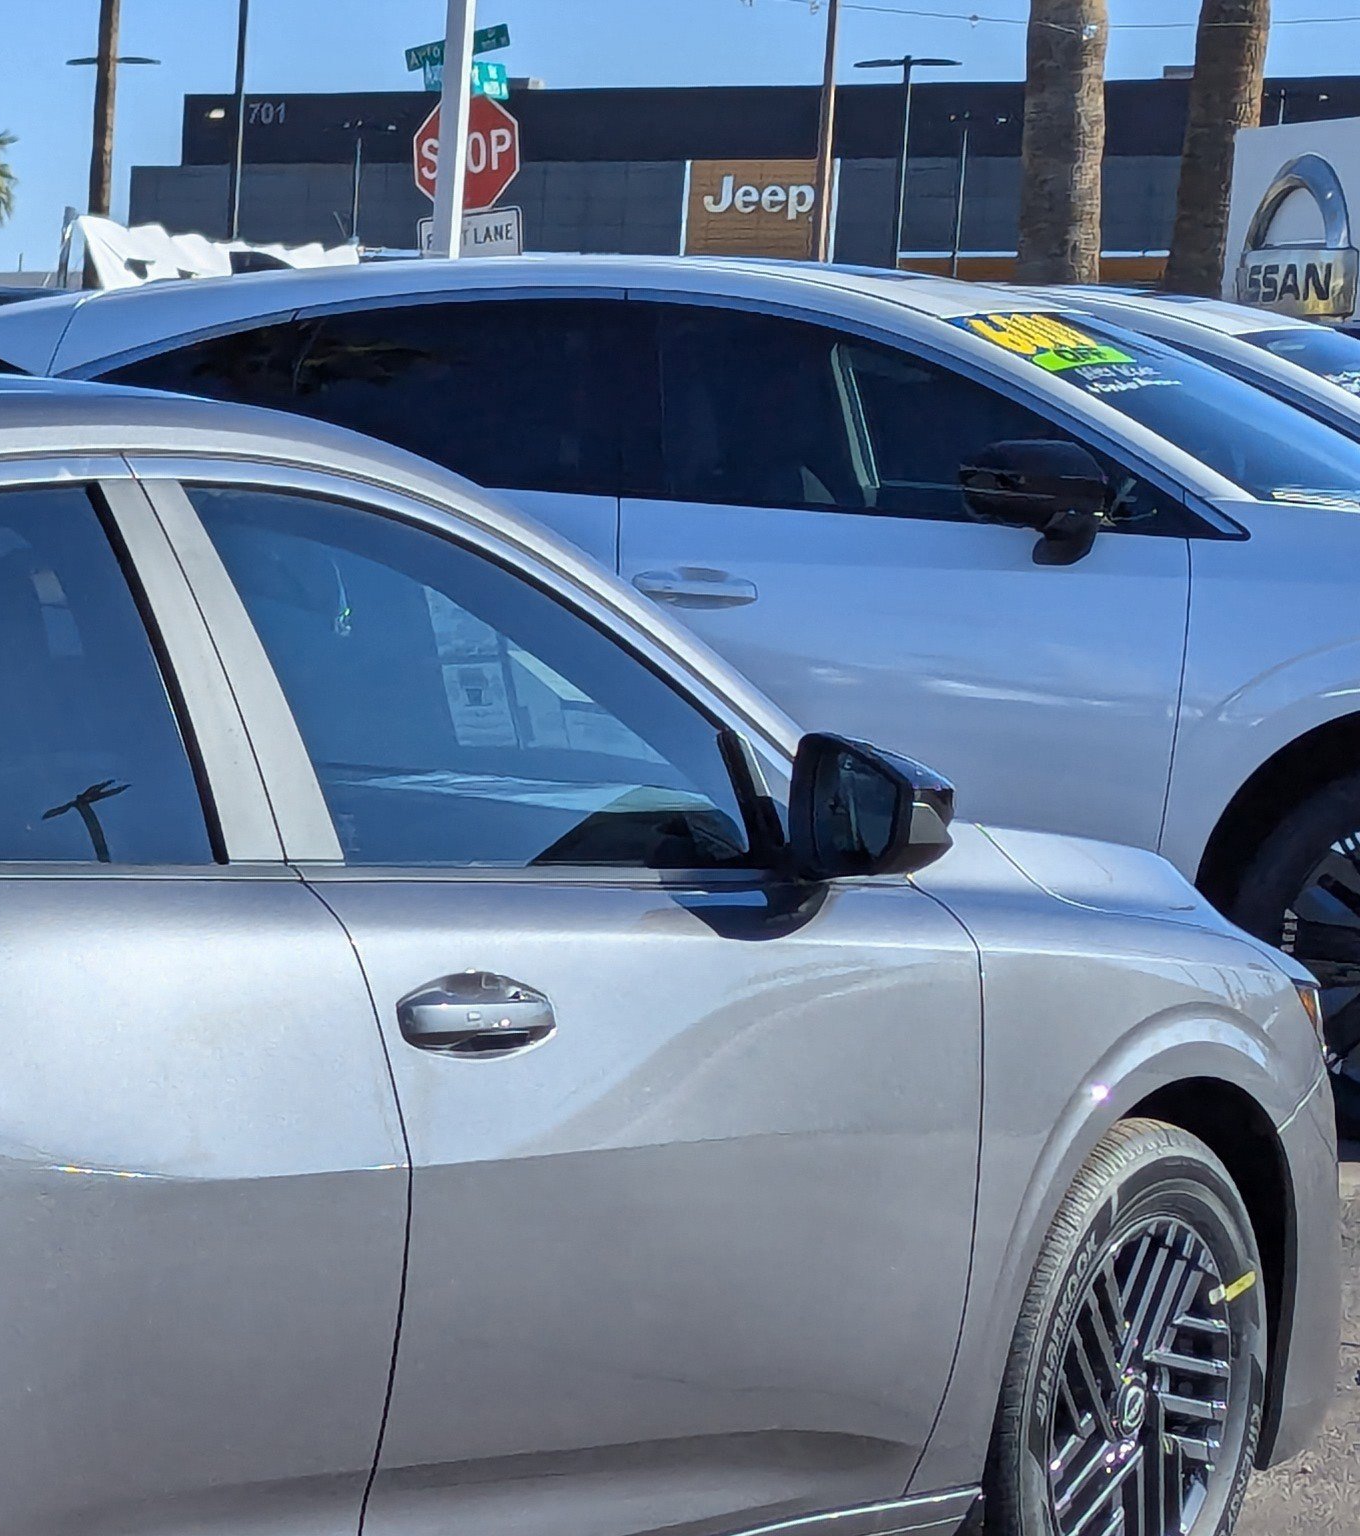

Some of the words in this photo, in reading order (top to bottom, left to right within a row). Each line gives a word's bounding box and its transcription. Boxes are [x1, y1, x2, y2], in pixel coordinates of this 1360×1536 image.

[249, 102, 286, 124] 701
[421, 128, 512, 180] SOP
[703, 175, 815, 220] Jeep
[474, 223, 514, 245] LANE
